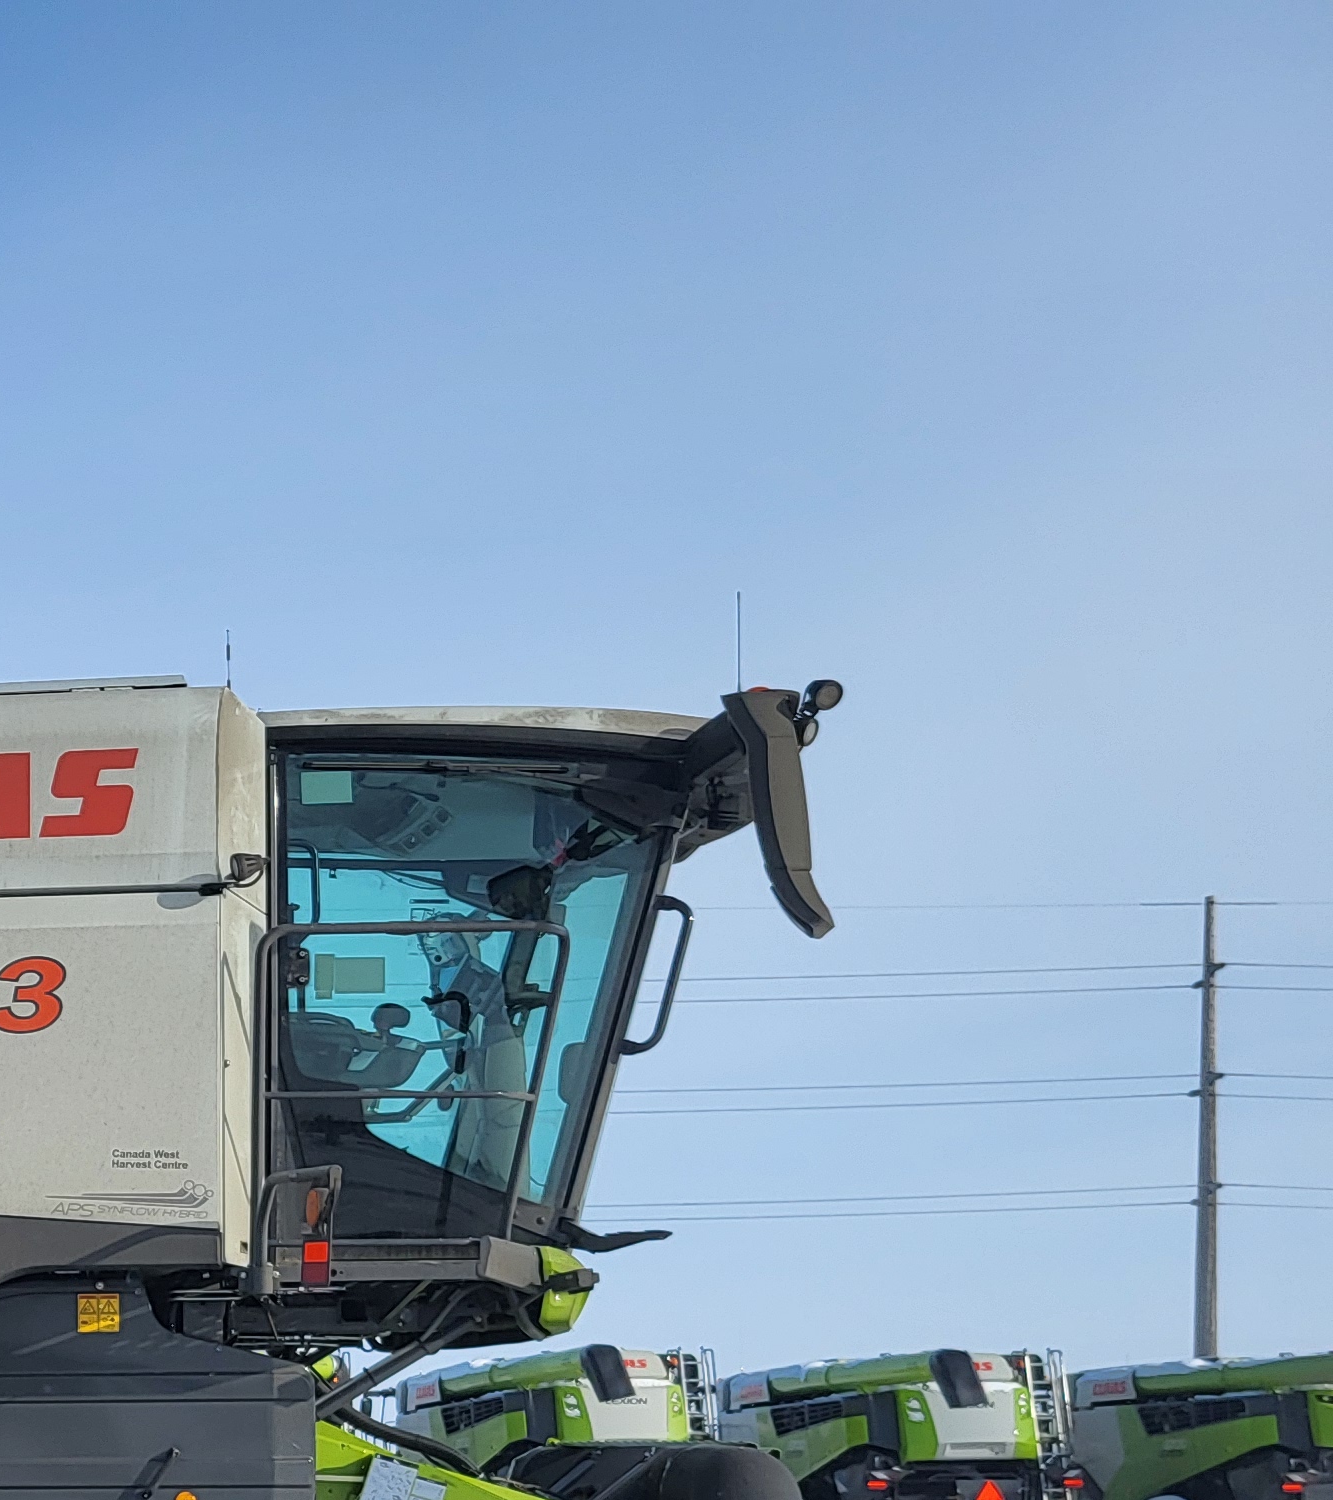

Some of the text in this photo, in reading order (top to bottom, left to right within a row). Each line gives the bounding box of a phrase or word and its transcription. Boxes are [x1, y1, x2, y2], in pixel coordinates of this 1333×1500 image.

[112, 1149, 180, 1159] Canada West
[111, 1160, 189, 1170] Harvest Centre
[50, 1201, 209, 1219] APS SYNFLOW HYBRID
